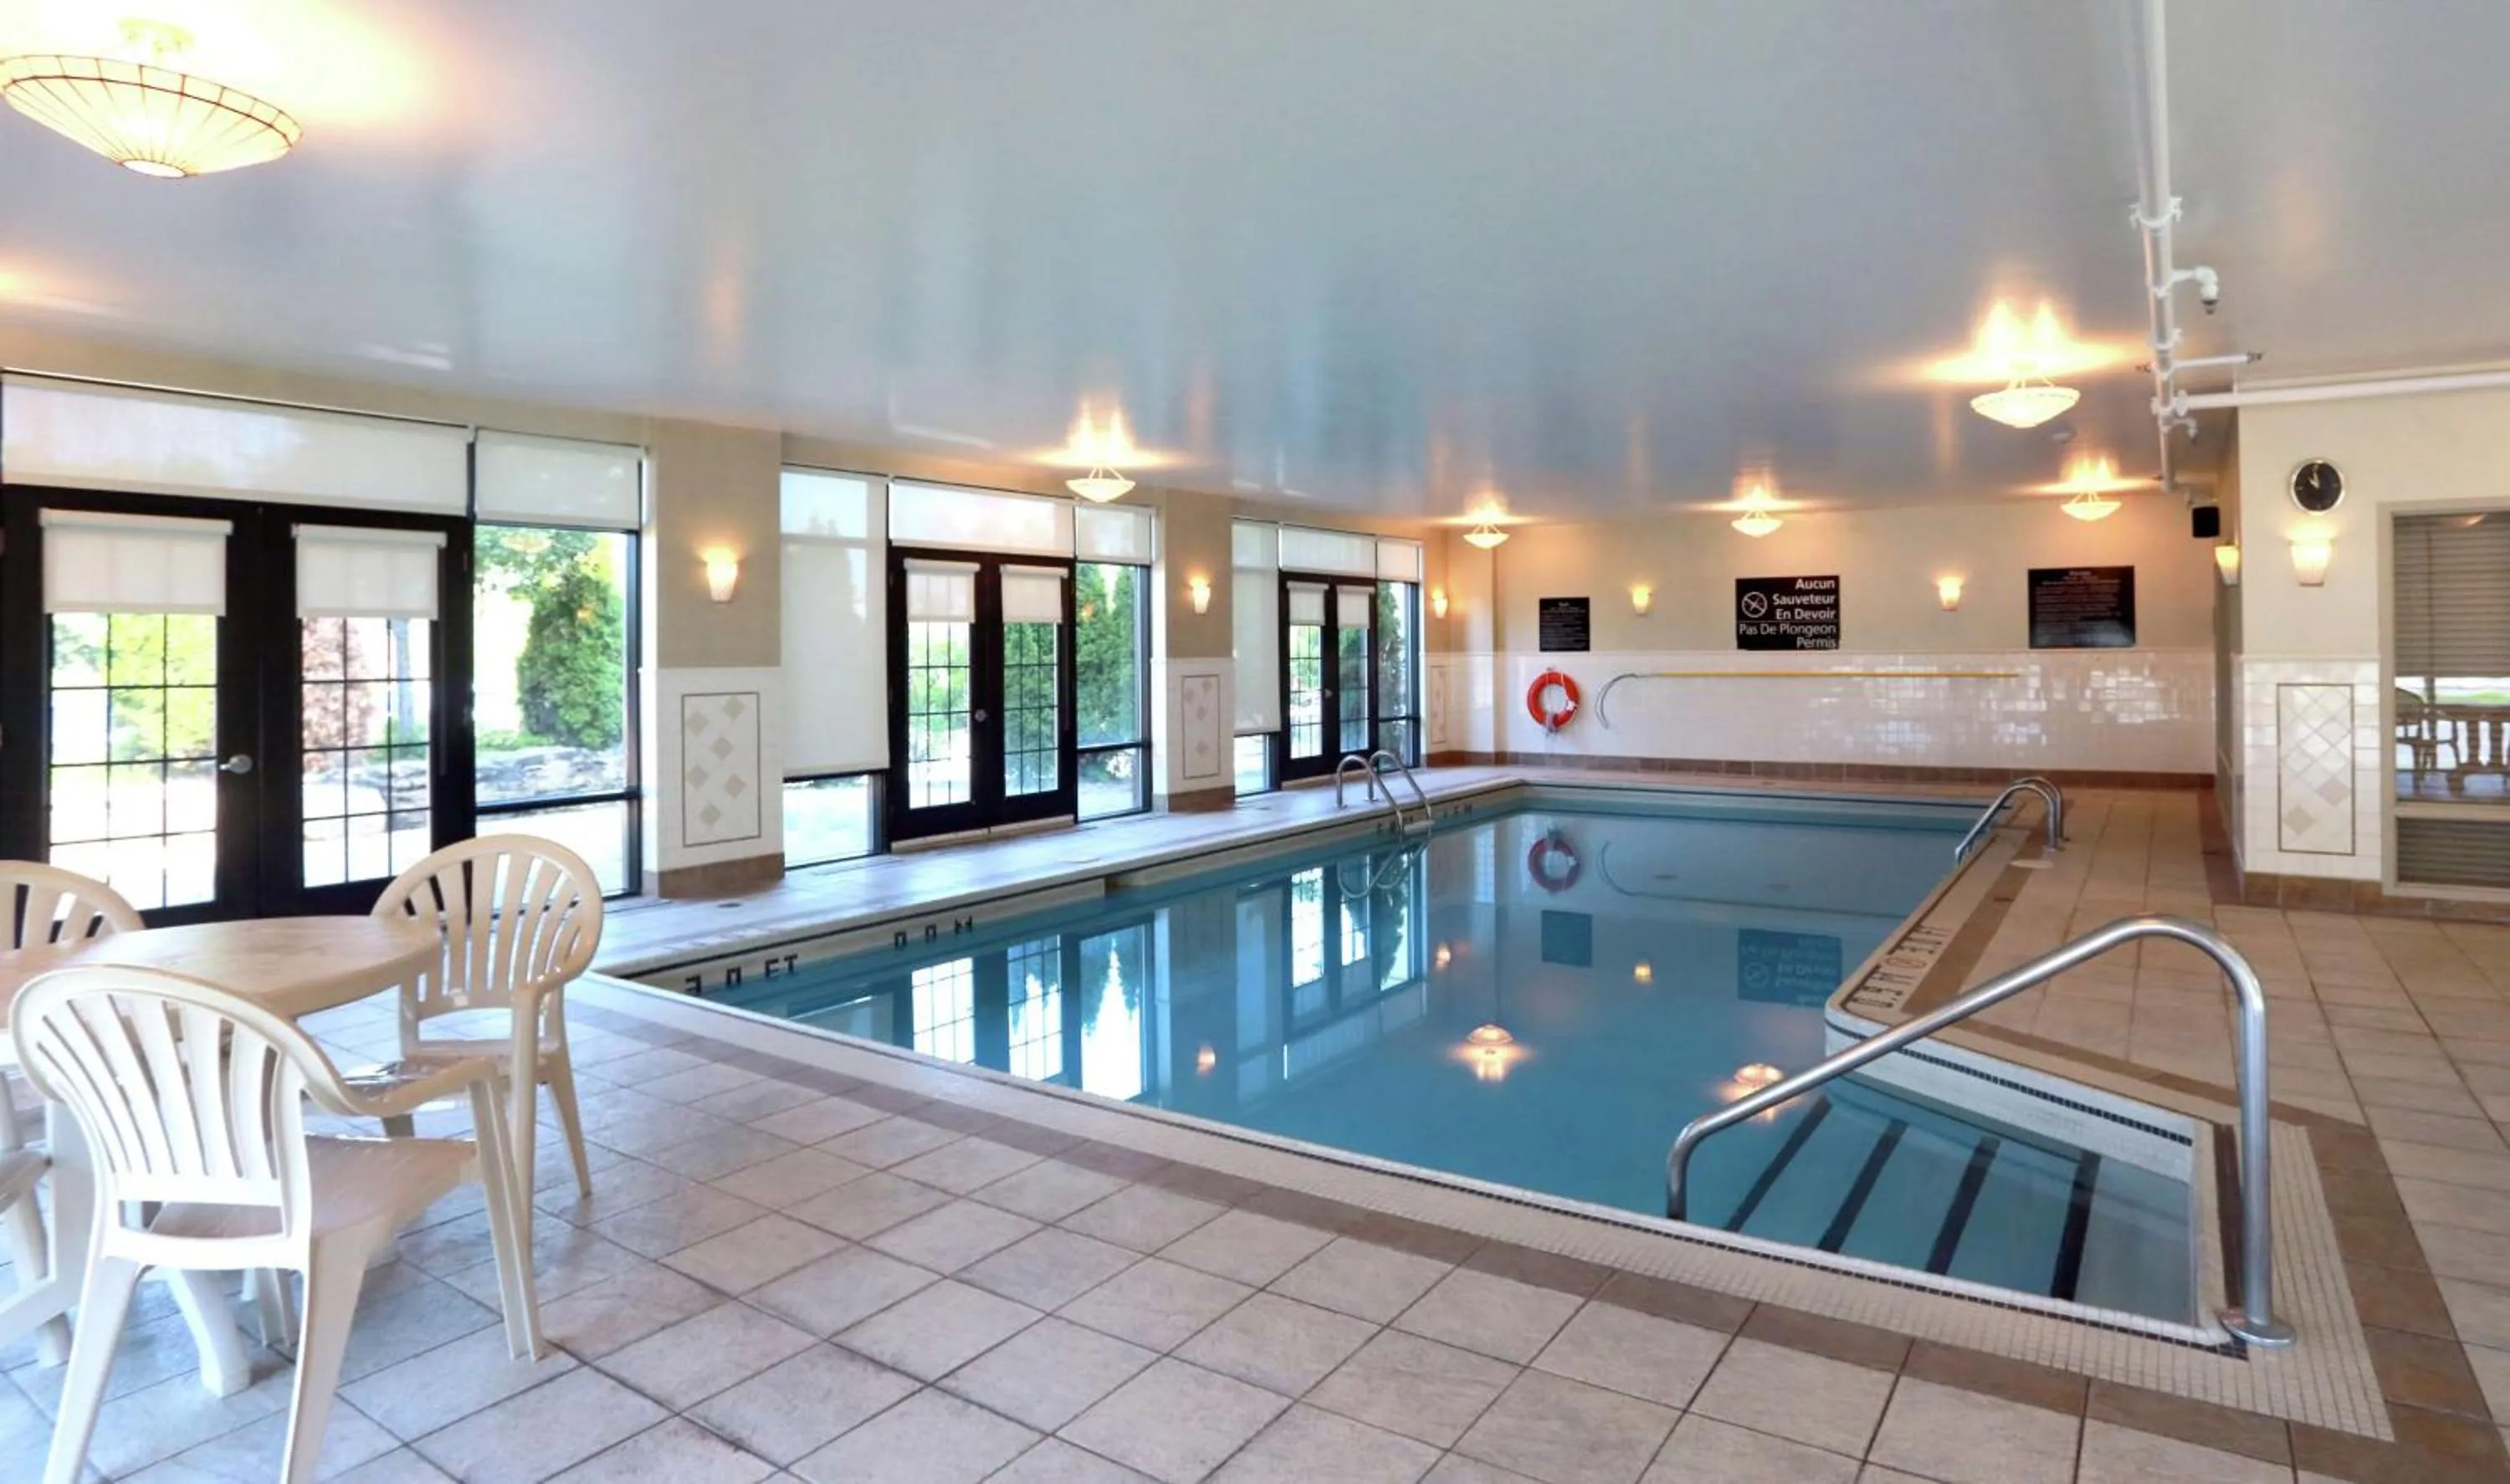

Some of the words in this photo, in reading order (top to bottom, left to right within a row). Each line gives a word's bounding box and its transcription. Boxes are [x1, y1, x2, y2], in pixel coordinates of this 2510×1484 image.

[1795, 578, 1836, 590] Aucun
[1772, 593, 1836, 605] Sauveteur
[1775, 608, 1791, 620] En
[1795, 607, 1836, 620] Devoir
[1739, 623, 1759, 635] Pas
[1760, 623, 1777, 635] De
[1780, 623, 1836, 637] Plongeon
[1796, 637, 1836, 649] Permis
